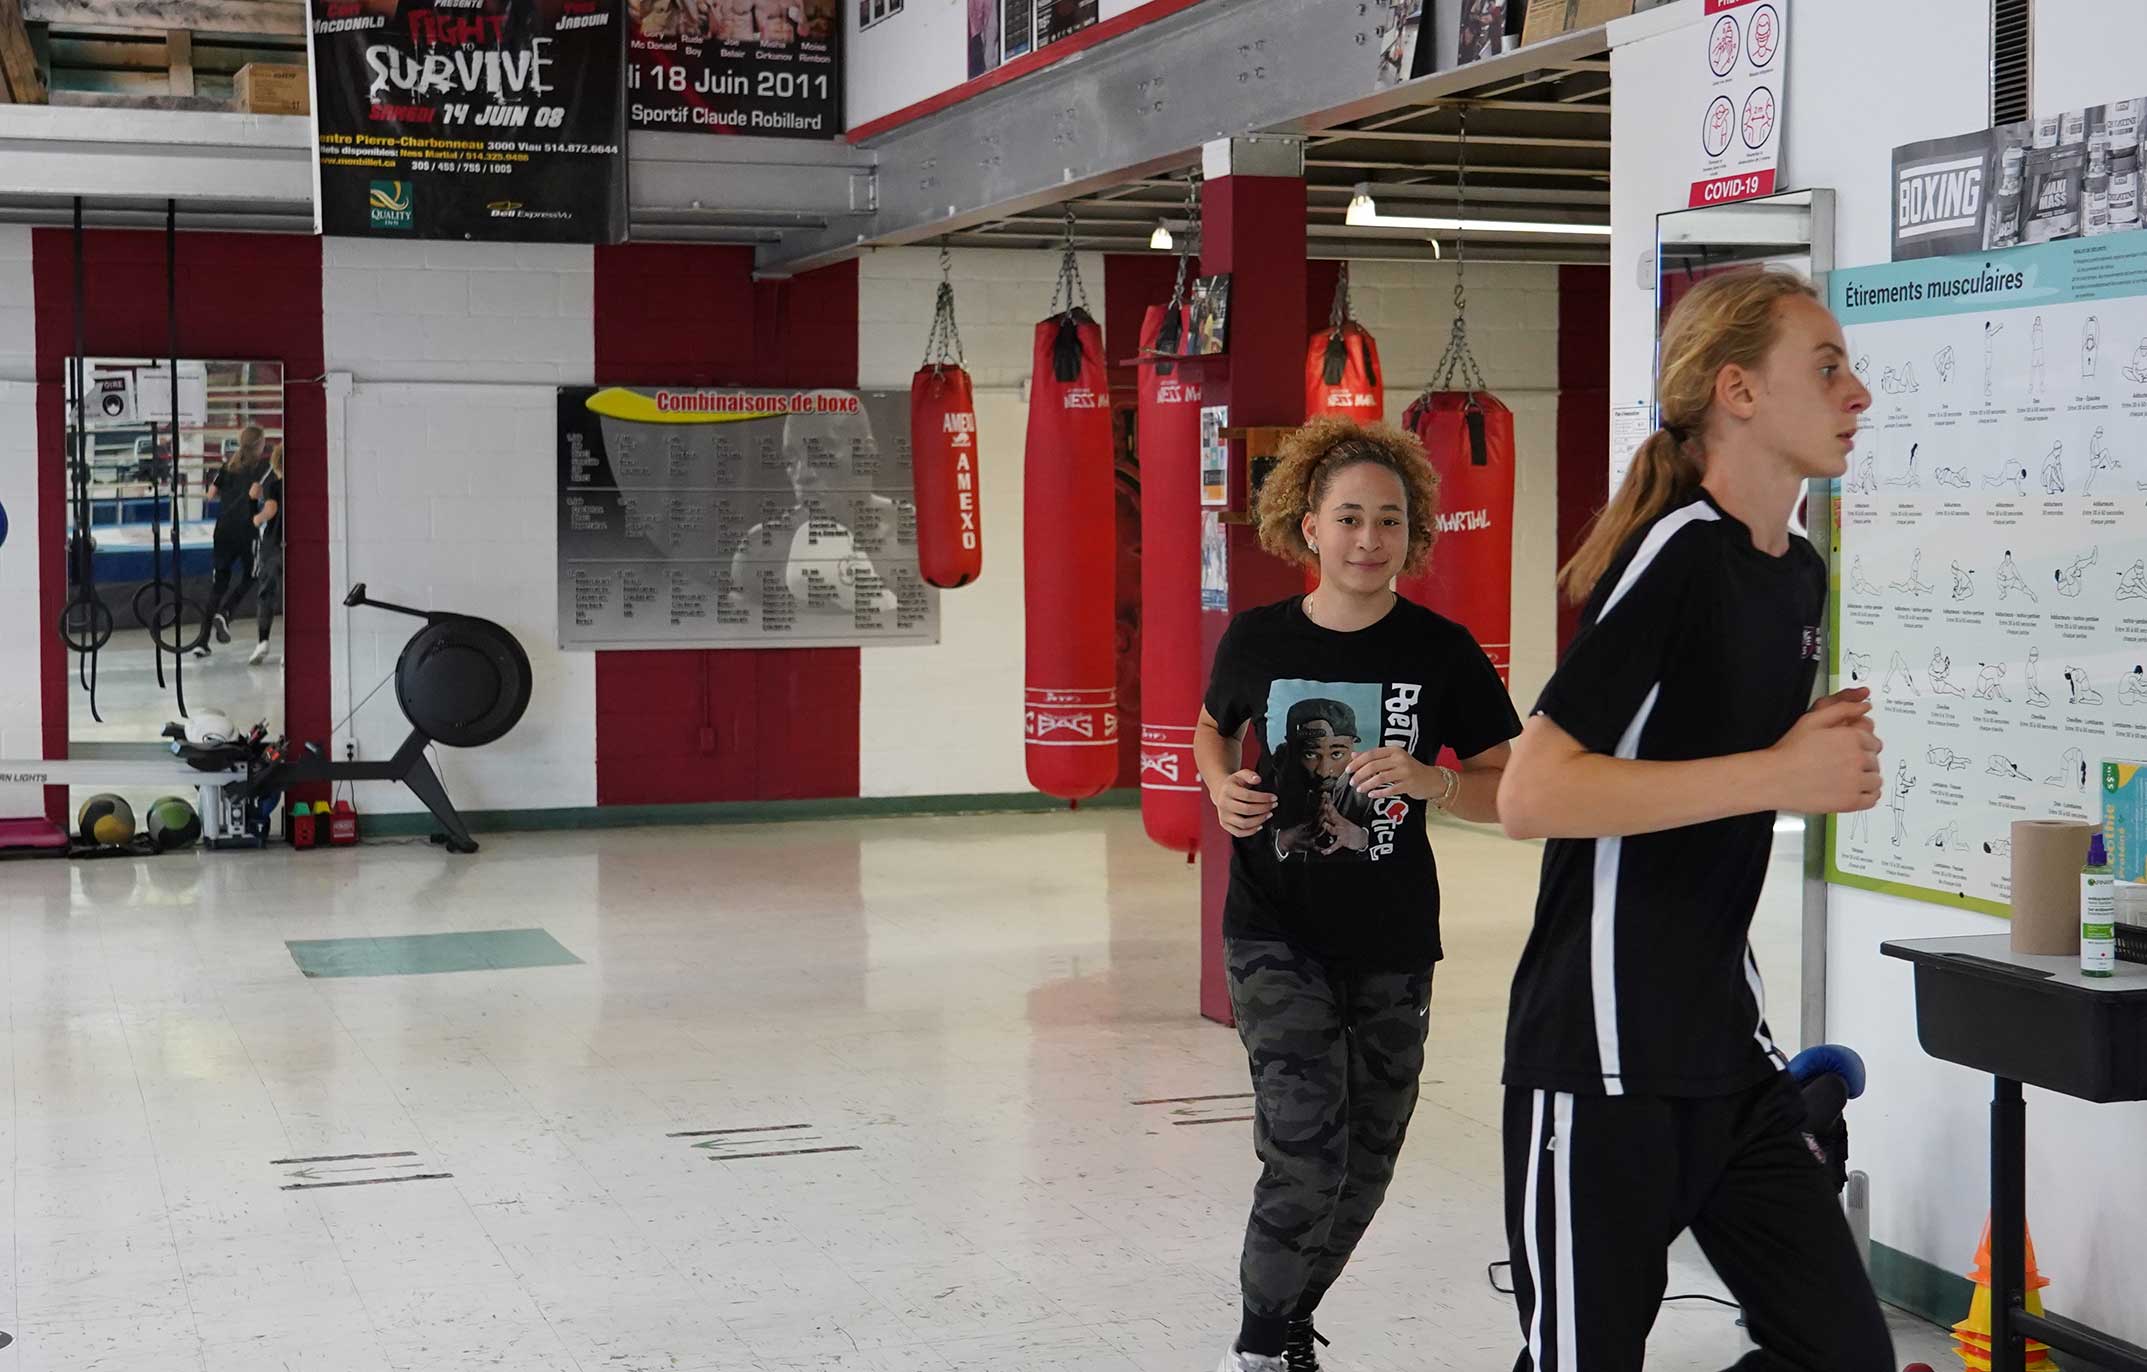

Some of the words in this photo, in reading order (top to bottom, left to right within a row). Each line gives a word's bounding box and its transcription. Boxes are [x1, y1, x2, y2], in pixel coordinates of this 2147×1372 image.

[555, 13, 609, 30] JABOUIN
[366, 38, 554, 98] SURVIVE
[650, 65, 687, 92] 18
[694, 68, 749, 95] Juin
[757, 71, 828, 99] 2011
[443, 103, 470, 124] 14
[475, 105, 529, 126] JUIN
[534, 106, 566, 128] 08
[632, 104, 688, 125] Sportif
[693, 107, 747, 126] Claude
[752, 110, 822, 130] Robillard
[320, 133, 353, 145] entre
[356, 133, 484, 150] Pierre-Charbonneau
[487, 142, 515, 151] 3000
[1704, 176, 1759, 200] COVID-19
[1899, 169, 1982, 226] BOXING
[2039, 193, 2067, 210] MASS
[371, 209, 412, 221] QUALITY
[1846, 281, 1922, 308] Étirements
[1927, 269, 2023, 299] musculaires
[657, 391, 787, 413] Combinaisons
[790, 393, 813, 413] de
[816, 393, 860, 414] boxe
[956, 452, 976, 550] AMEXO
[1038, 713, 1093, 737] BAG
